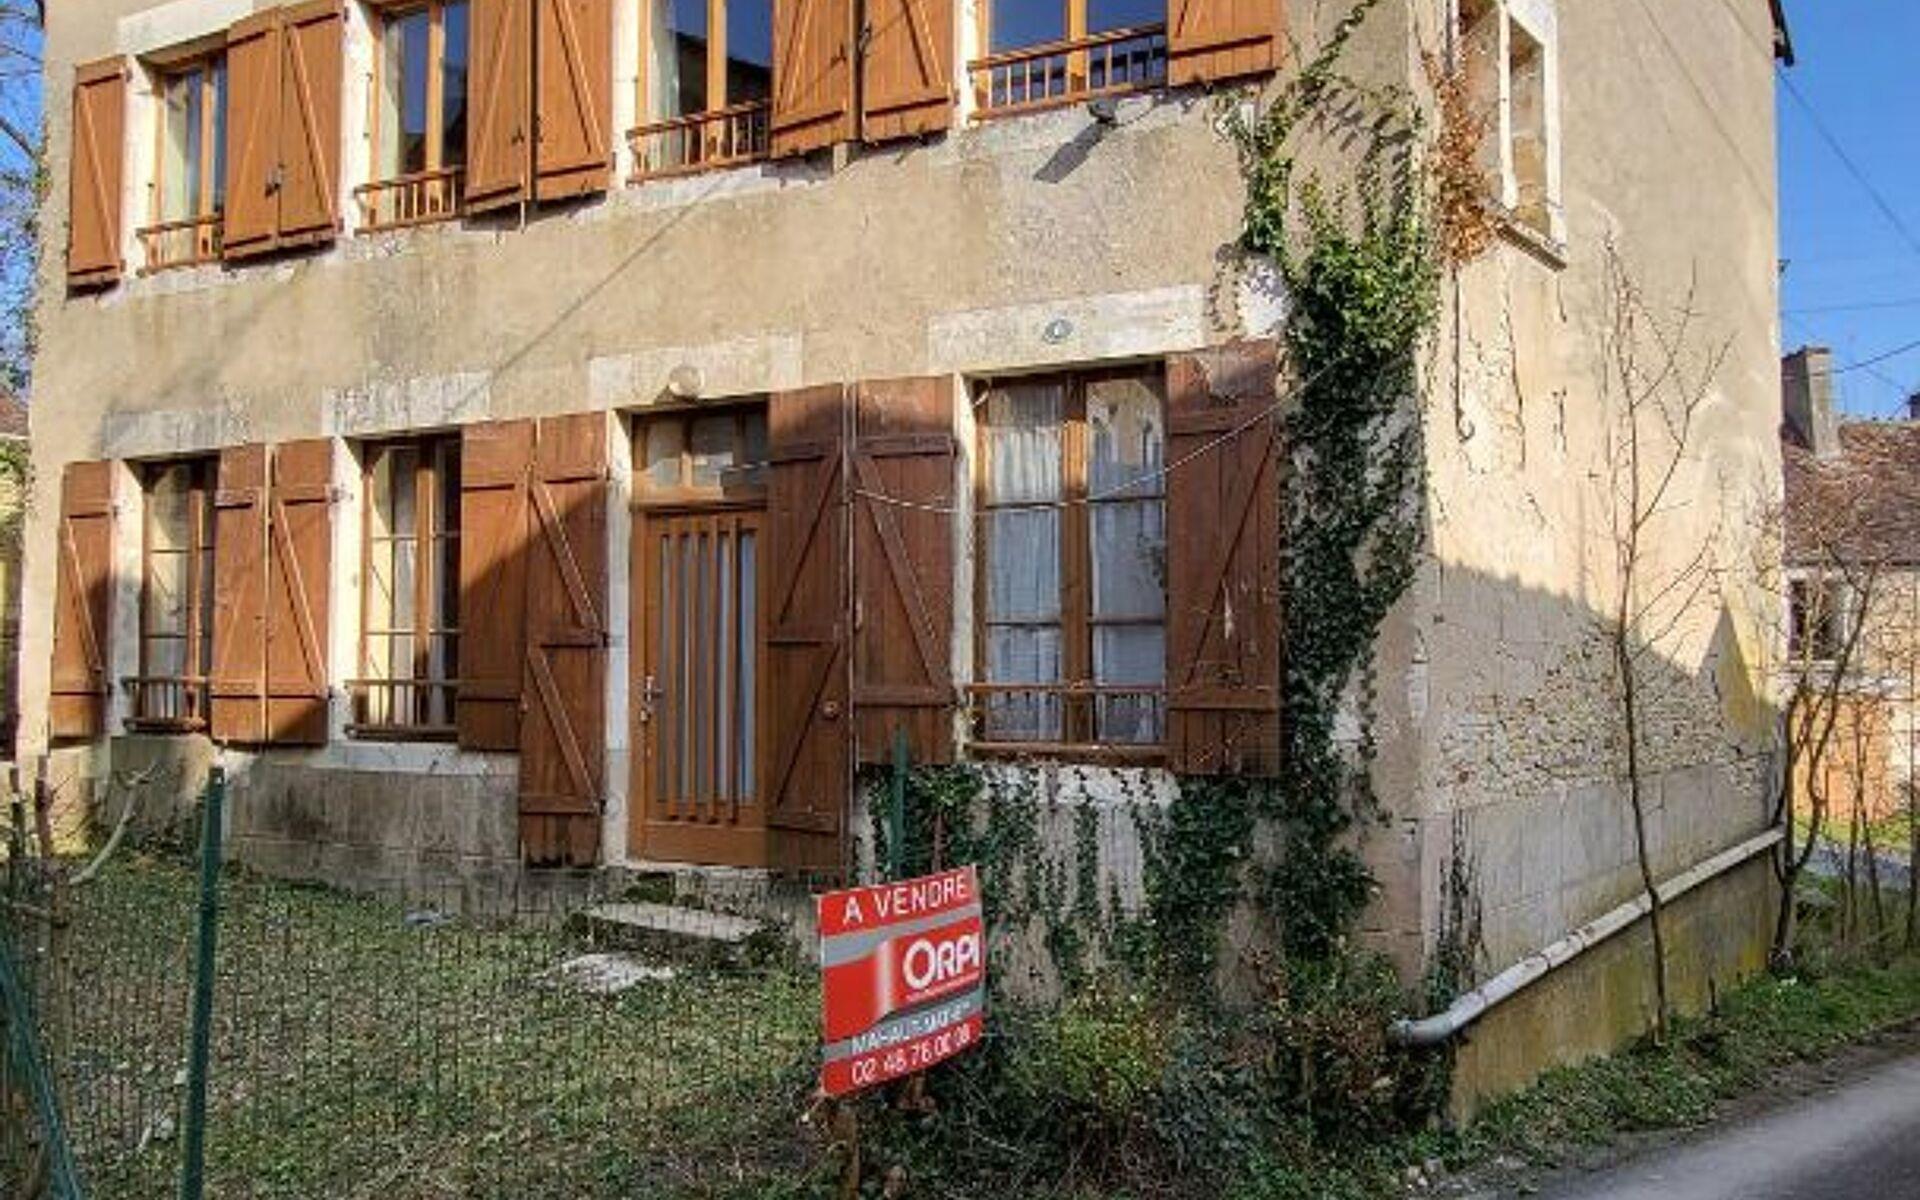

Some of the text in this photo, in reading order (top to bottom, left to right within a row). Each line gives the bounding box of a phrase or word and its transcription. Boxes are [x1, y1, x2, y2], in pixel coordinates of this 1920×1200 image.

[842, 874, 969, 925] A VENDRE
[903, 933, 980, 989] ORPI
